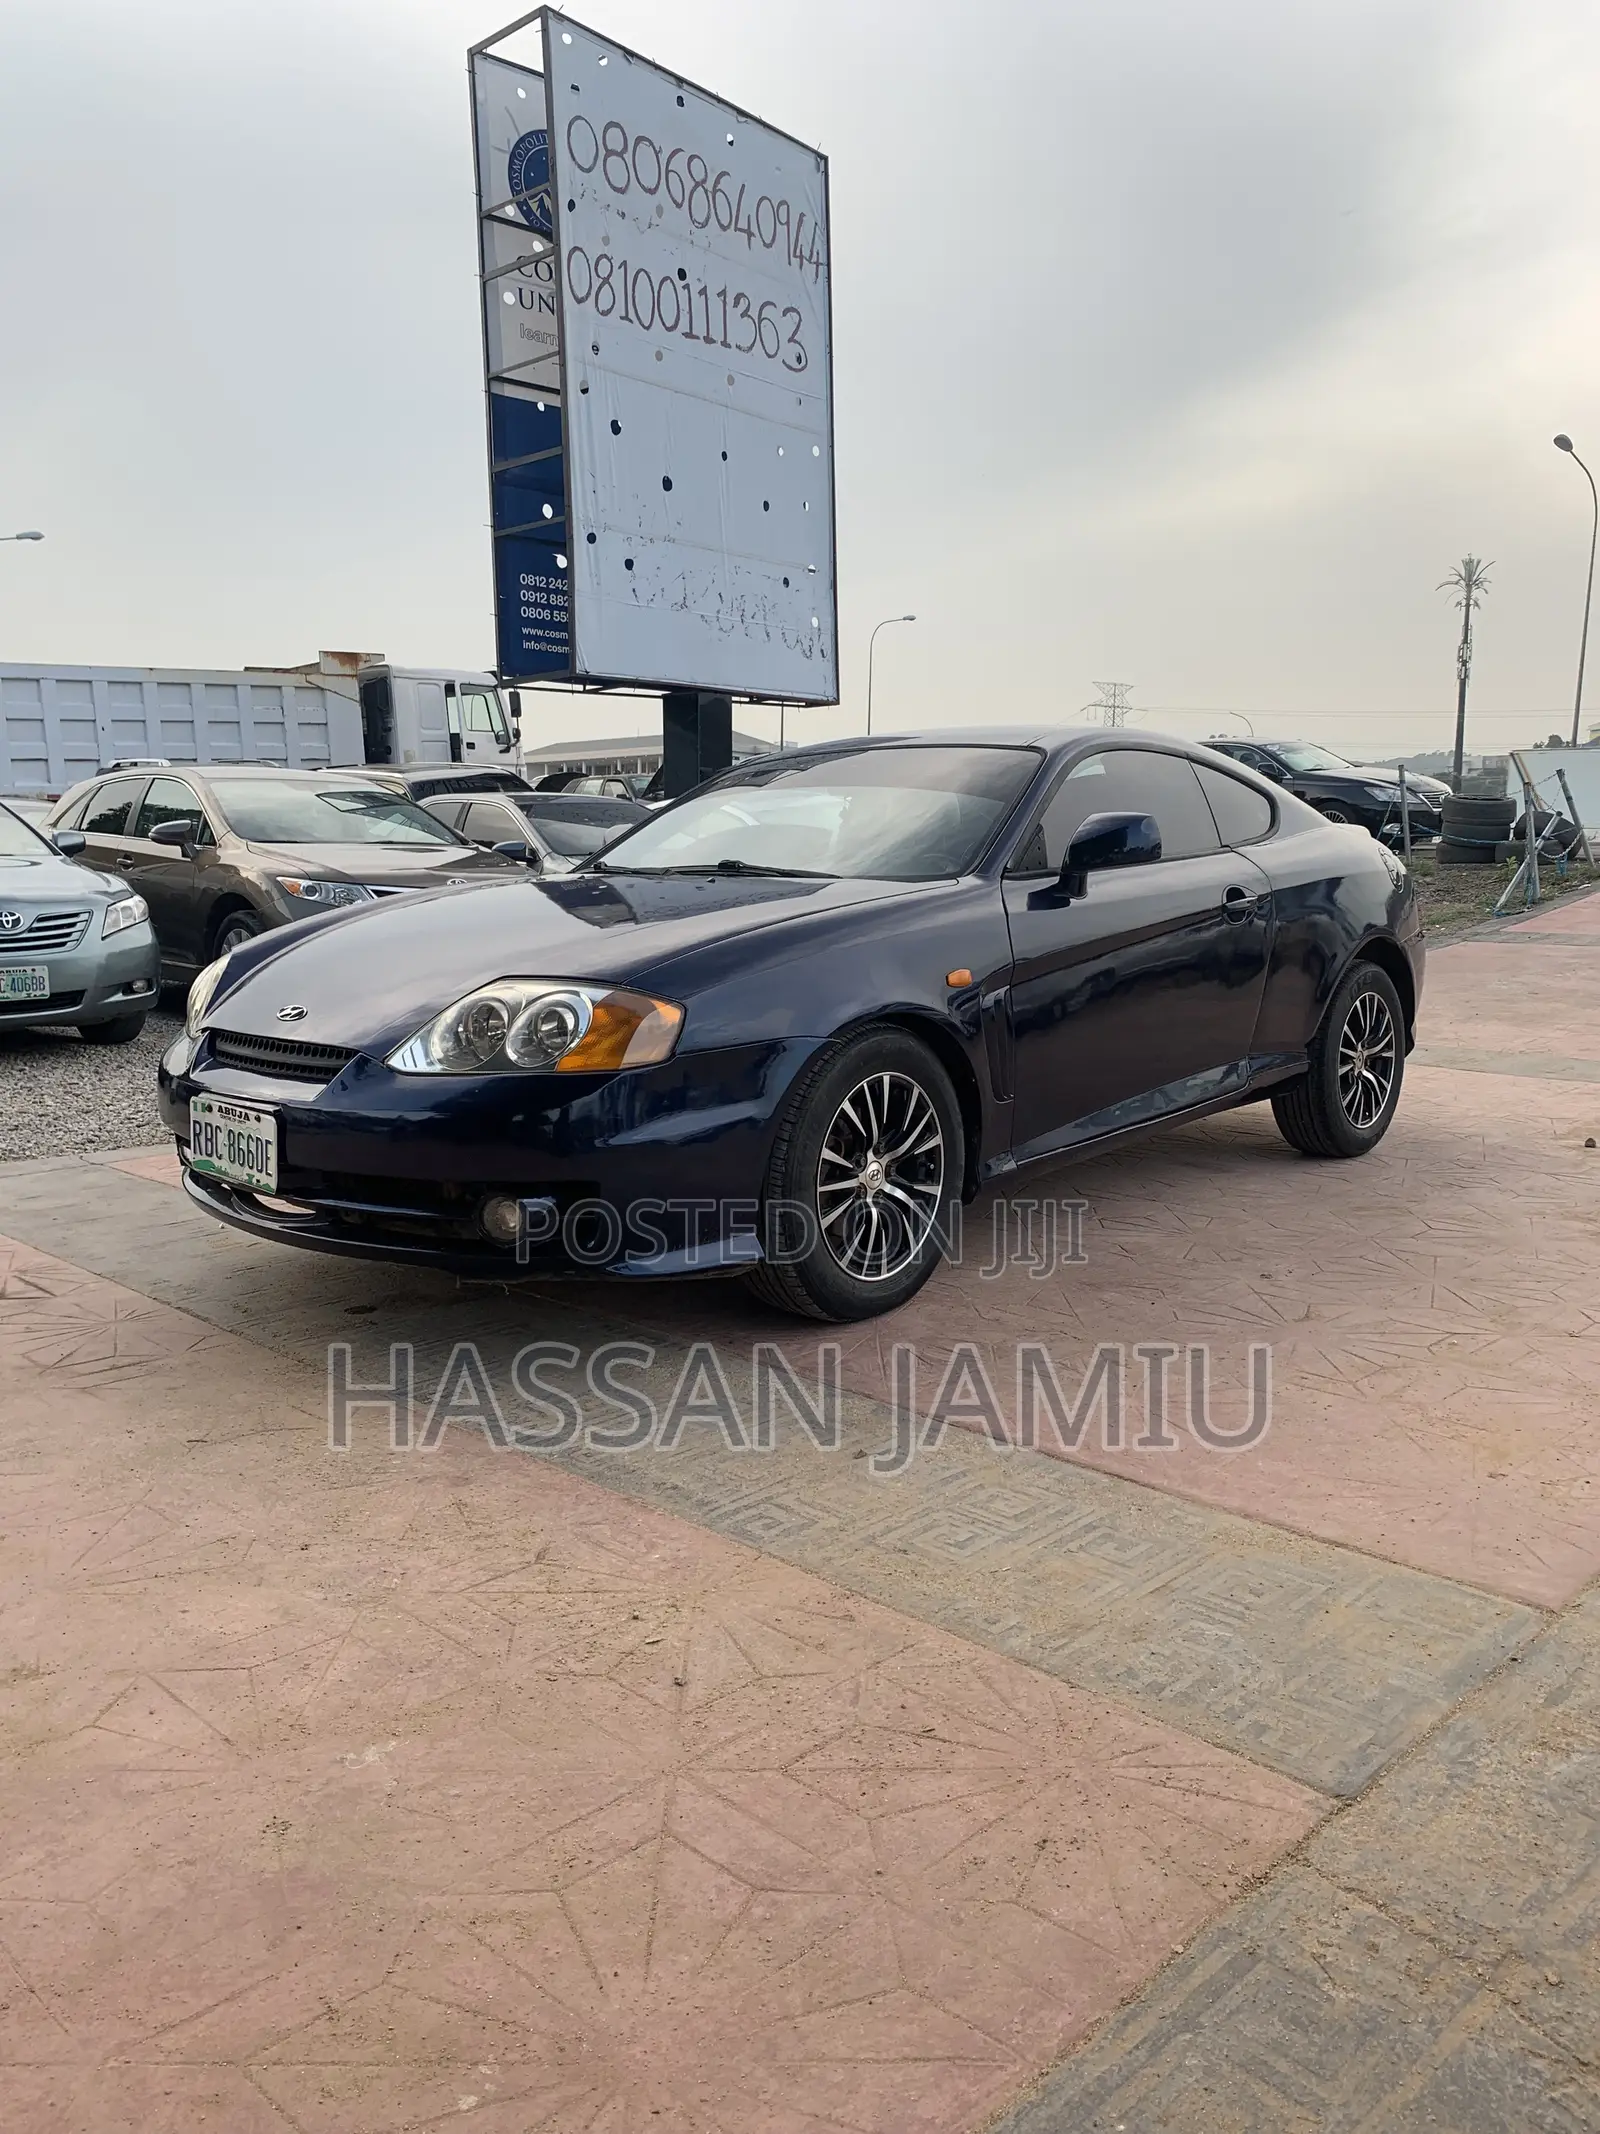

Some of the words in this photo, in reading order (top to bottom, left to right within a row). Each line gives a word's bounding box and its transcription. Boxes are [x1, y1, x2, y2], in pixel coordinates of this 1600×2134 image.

[567, 115, 827, 284] 08068640944
[517, 286, 556, 316] UN
[567, 246, 808, 373] 08100111363
[520, 322, 559, 347] learn
[520, 573, 547, 588] 0812
[520, 590, 548, 604] 0912
[520, 606, 551, 621] 0806
[553, 610, 569, 623] 55
[521, 626, 568, 640] www.cosm
[217, 1104, 251, 1122] ABUJA
